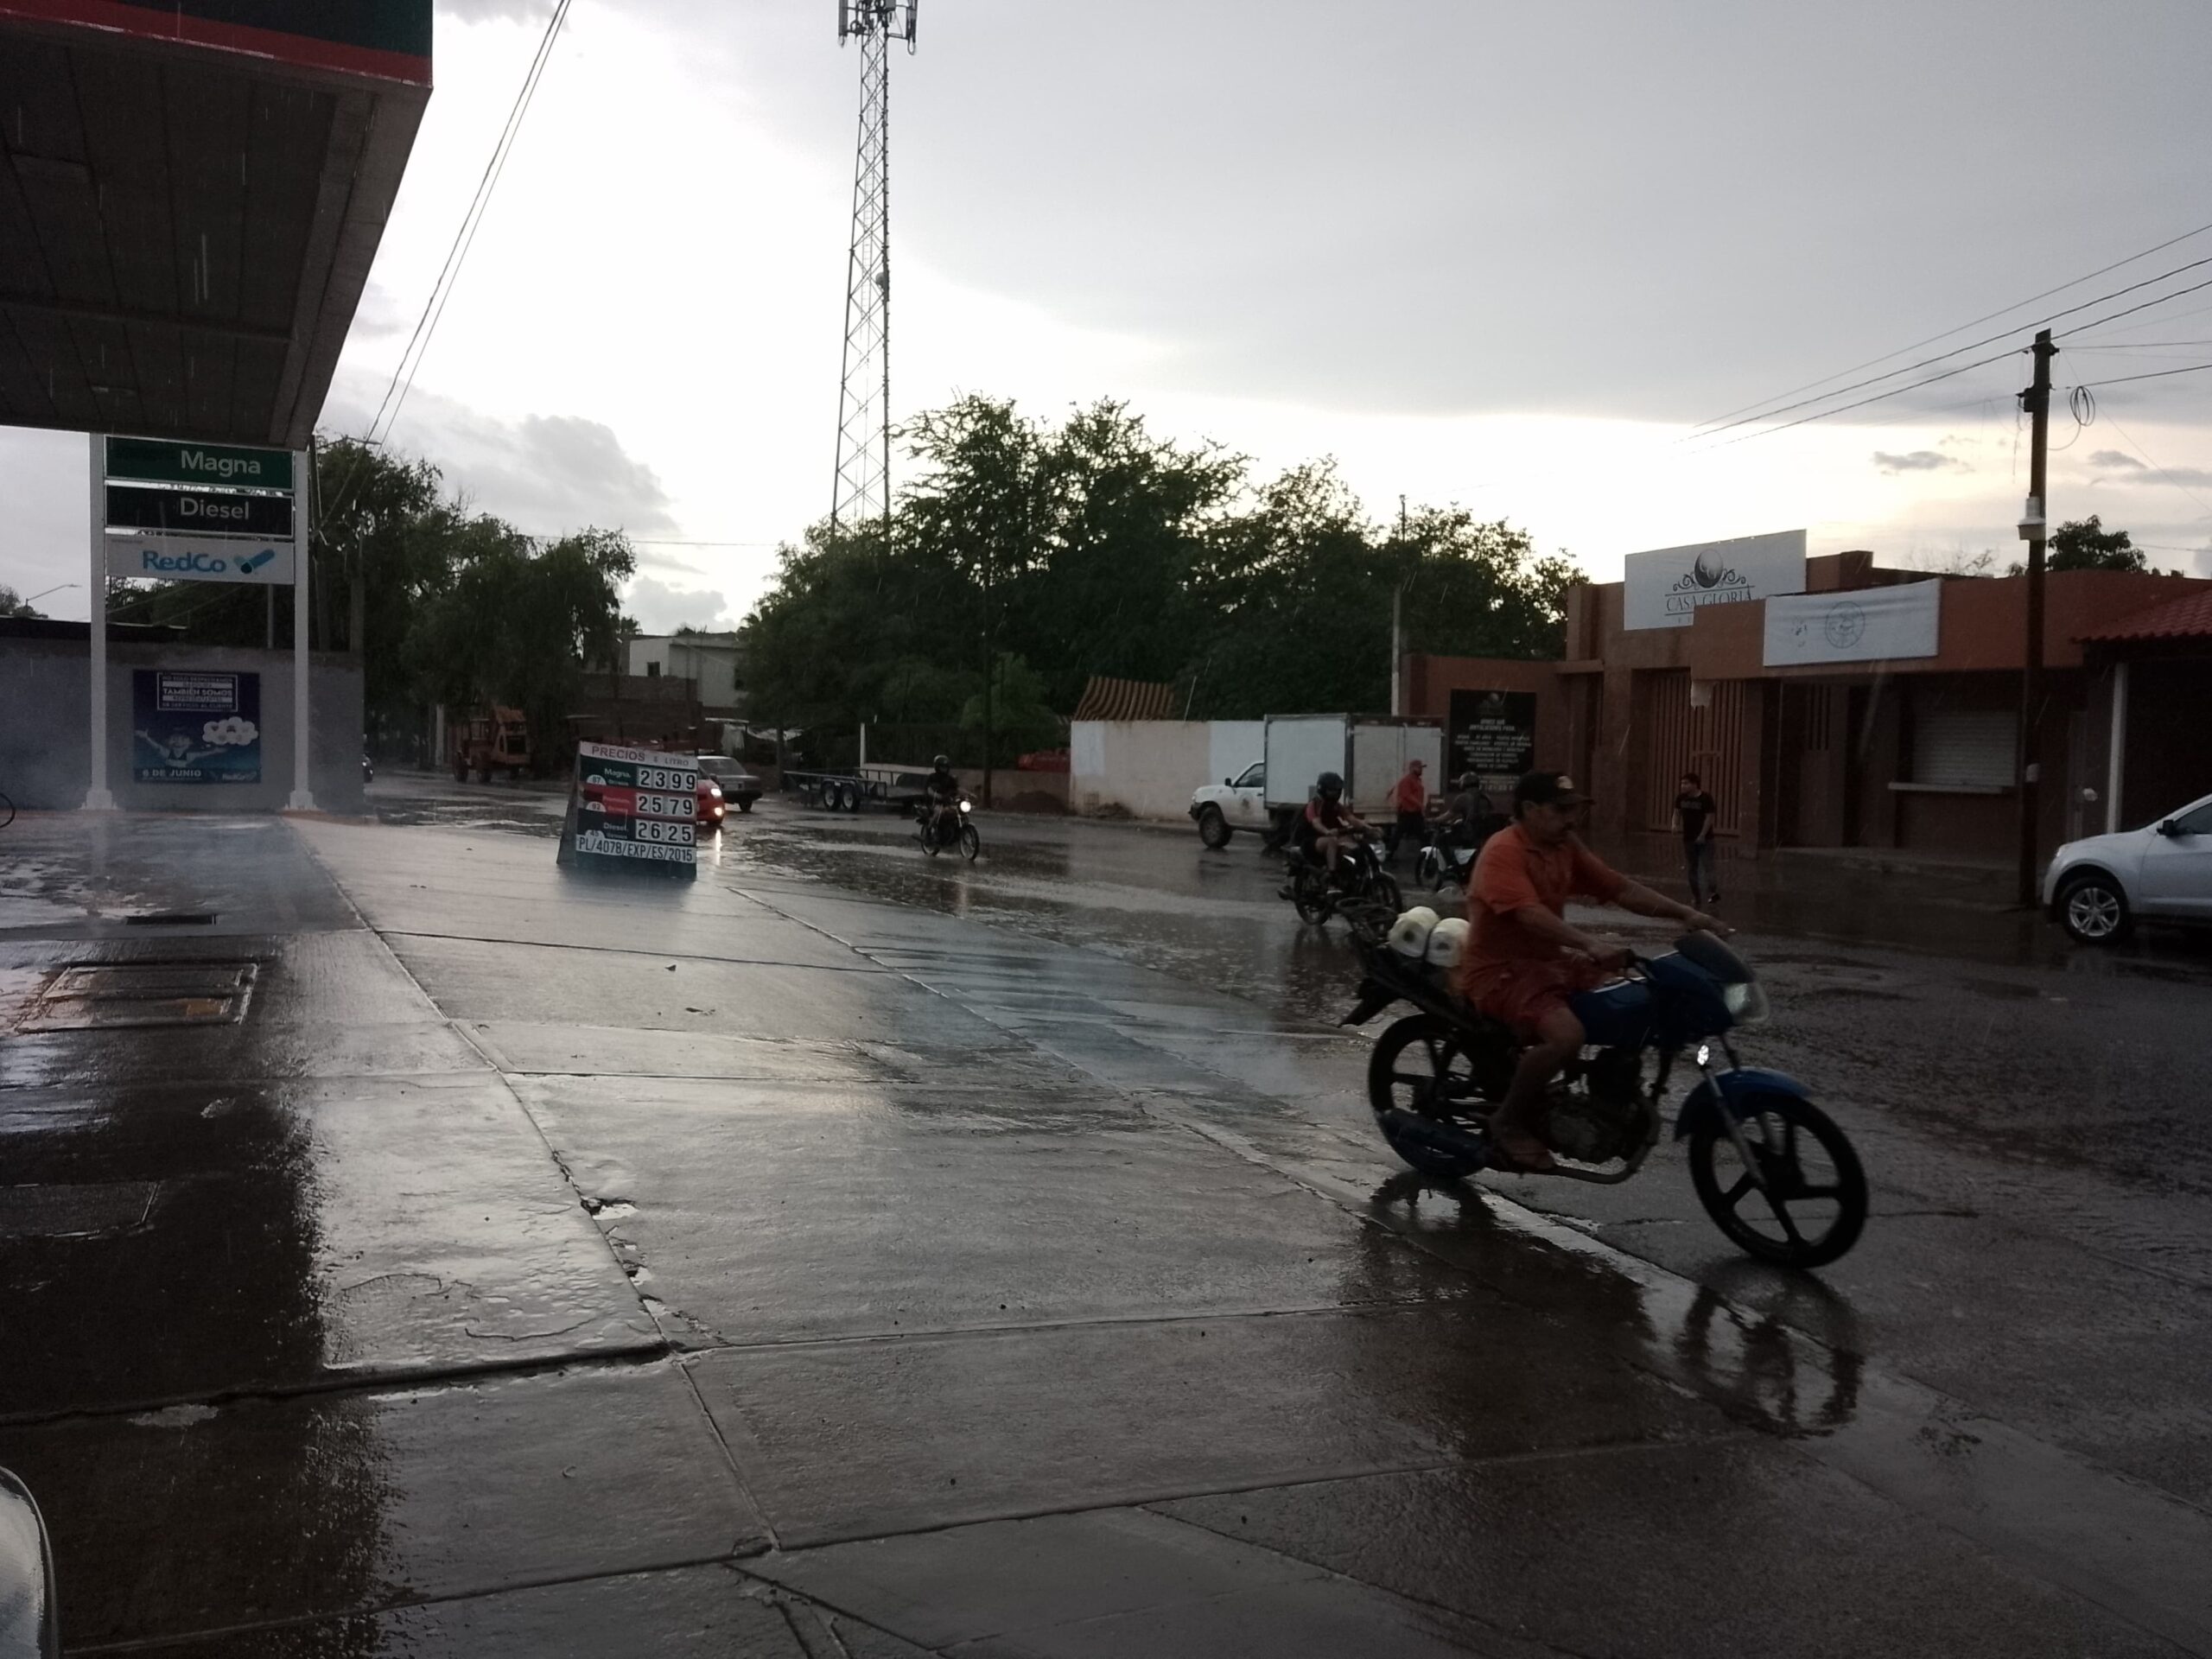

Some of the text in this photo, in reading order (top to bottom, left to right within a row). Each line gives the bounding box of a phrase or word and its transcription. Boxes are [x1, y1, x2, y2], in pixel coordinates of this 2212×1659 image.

[181, 449, 261, 477] Magna
[180, 497, 250, 520] Diesel
[142, 550, 226, 573] RedCo
[1666, 594, 1697, 612] CASA
[591, 746, 645, 762] PRECIOS
[664, 758, 690, 766] LITRO
[151, 769, 166, 778] DE
[169, 769, 202, 778] JUNIO
[639, 770, 696, 791] 23.99
[638, 822, 691, 842] 26.25
